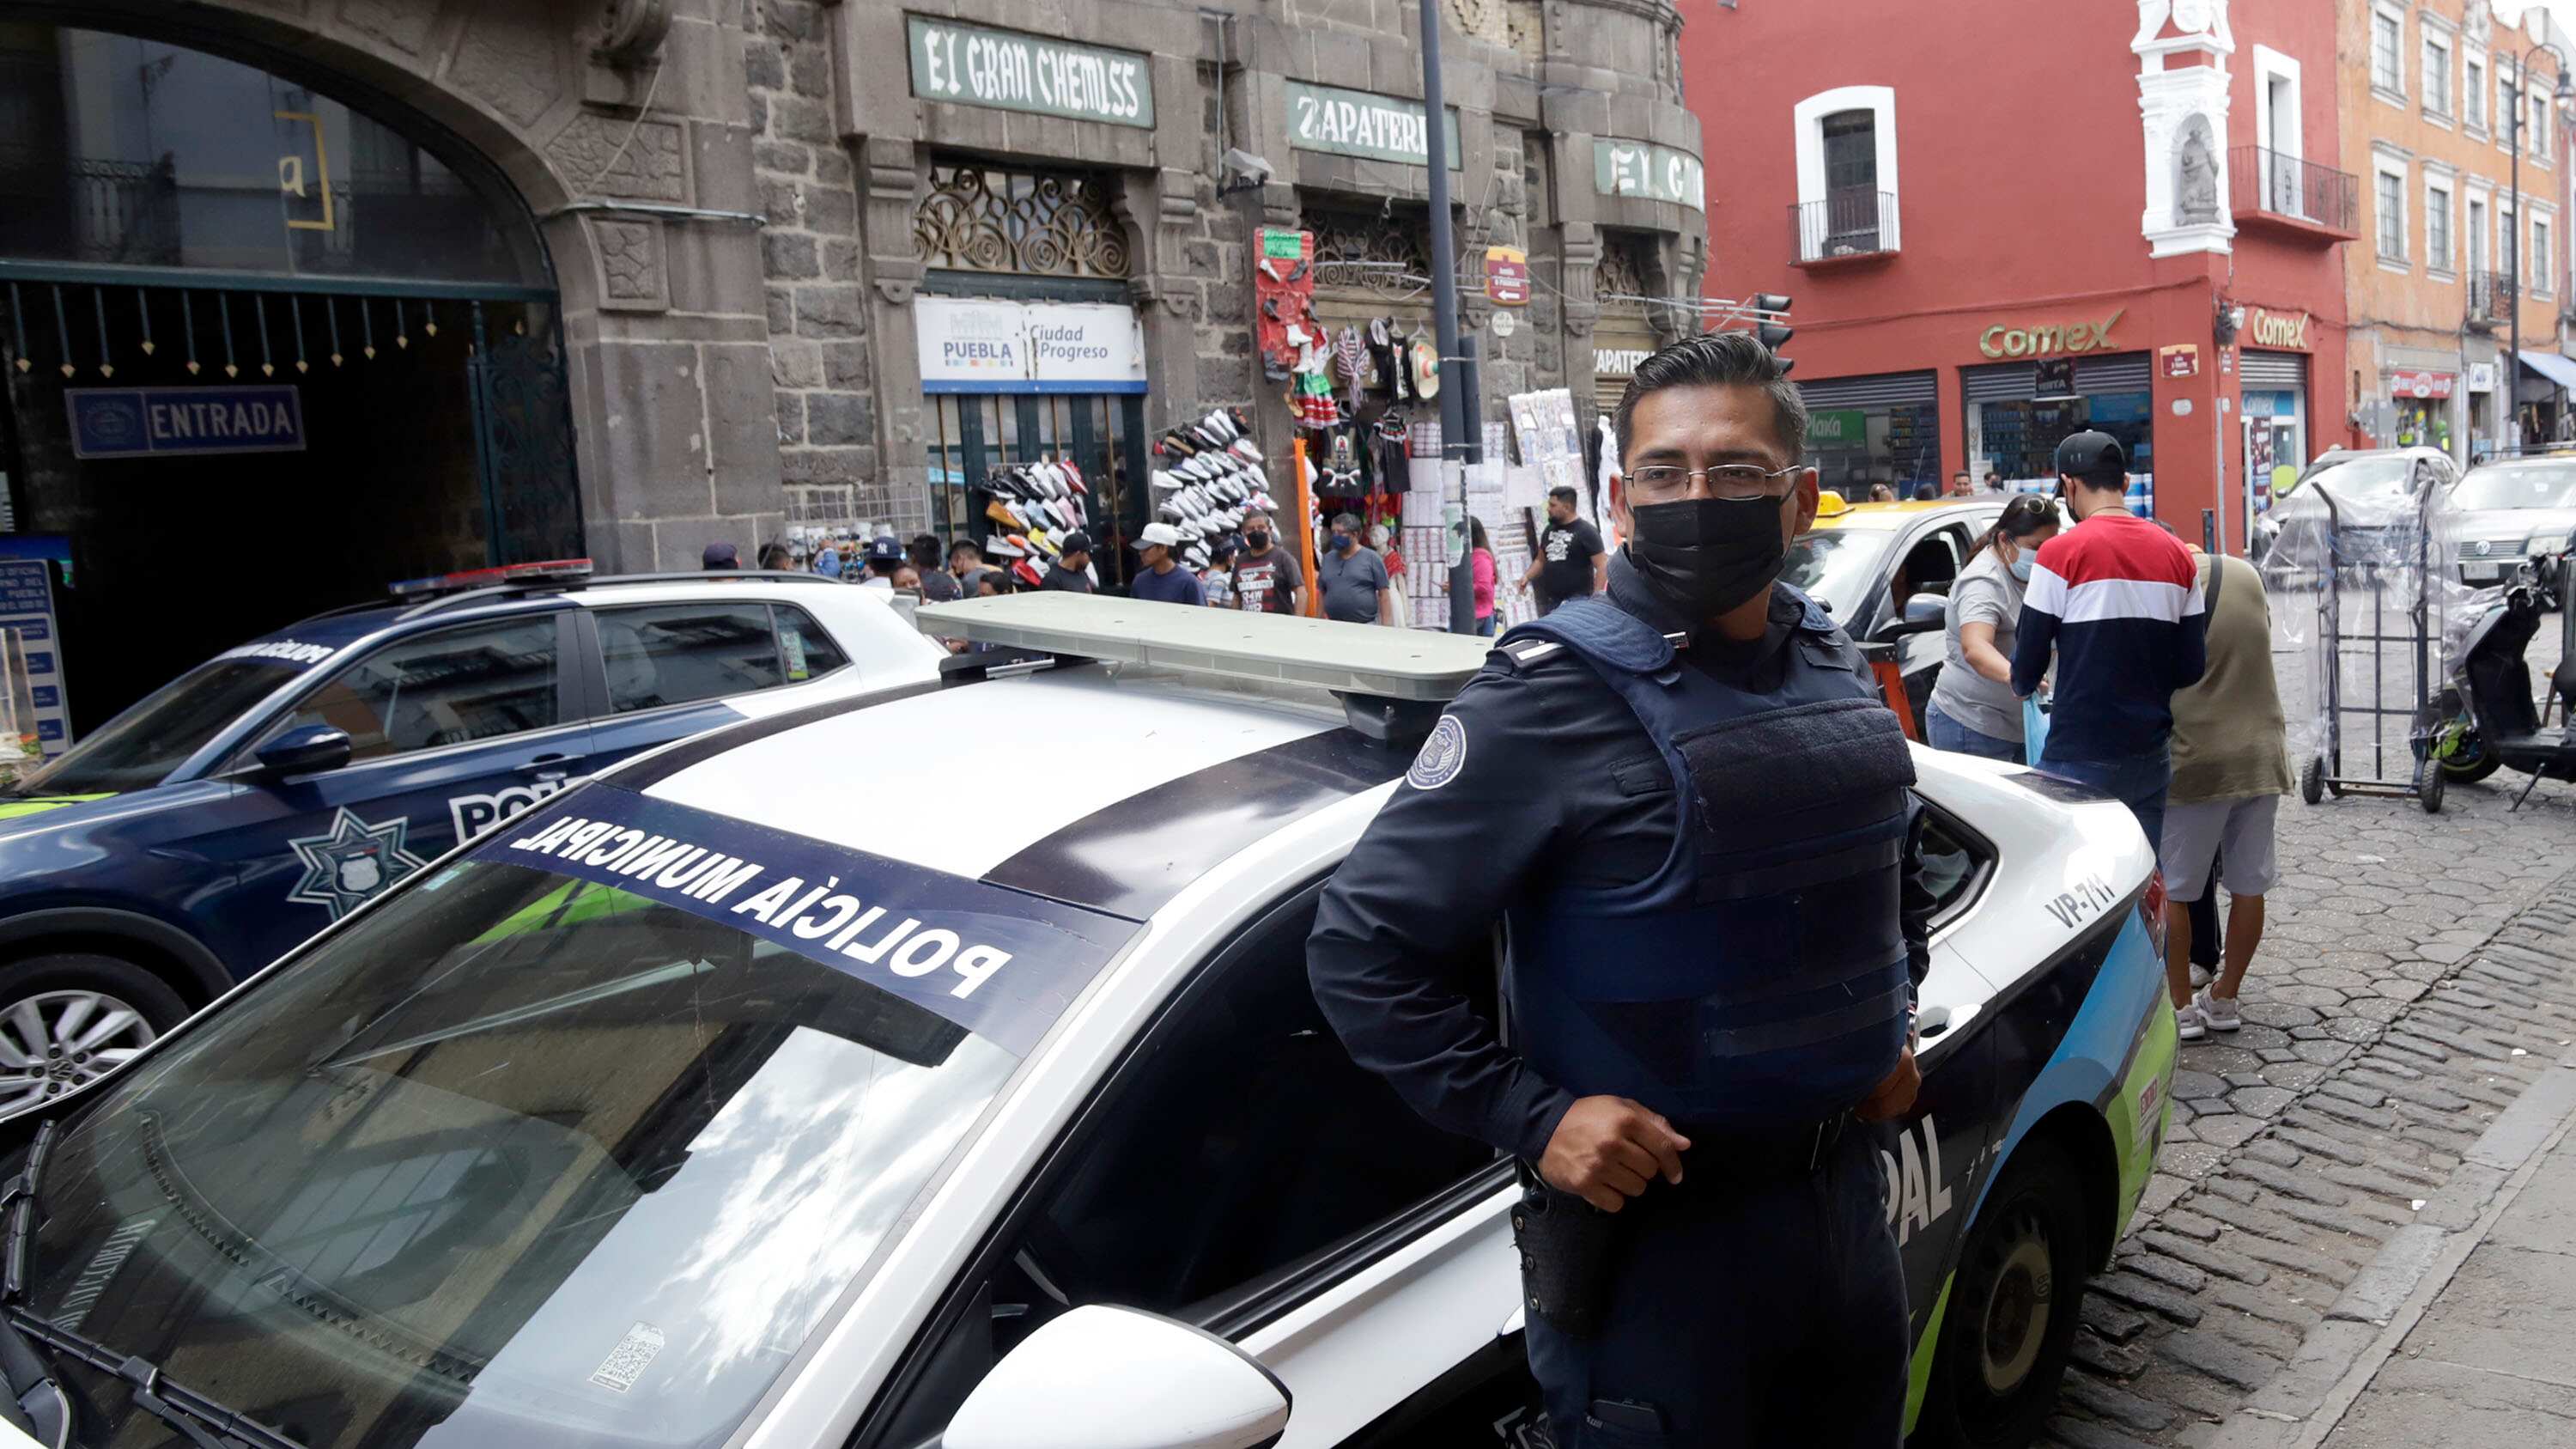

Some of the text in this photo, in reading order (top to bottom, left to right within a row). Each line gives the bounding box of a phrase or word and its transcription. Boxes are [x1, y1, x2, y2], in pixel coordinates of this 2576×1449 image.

[967, 35, 1033, 103] GRAN
[1297, 96, 1428, 155] ZAPATERI
[1030, 324, 1083, 343] Ciudad
[1980, 307, 2127, 358] Comex
[2252, 309, 2309, 350] Comex
[944, 342, 1012, 359] PUEBLA
[1040, 342, 1109, 362] Progreso
[150, 401, 294, 439] ENTRADA
[2044, 872, 2116, 929] VP-711
